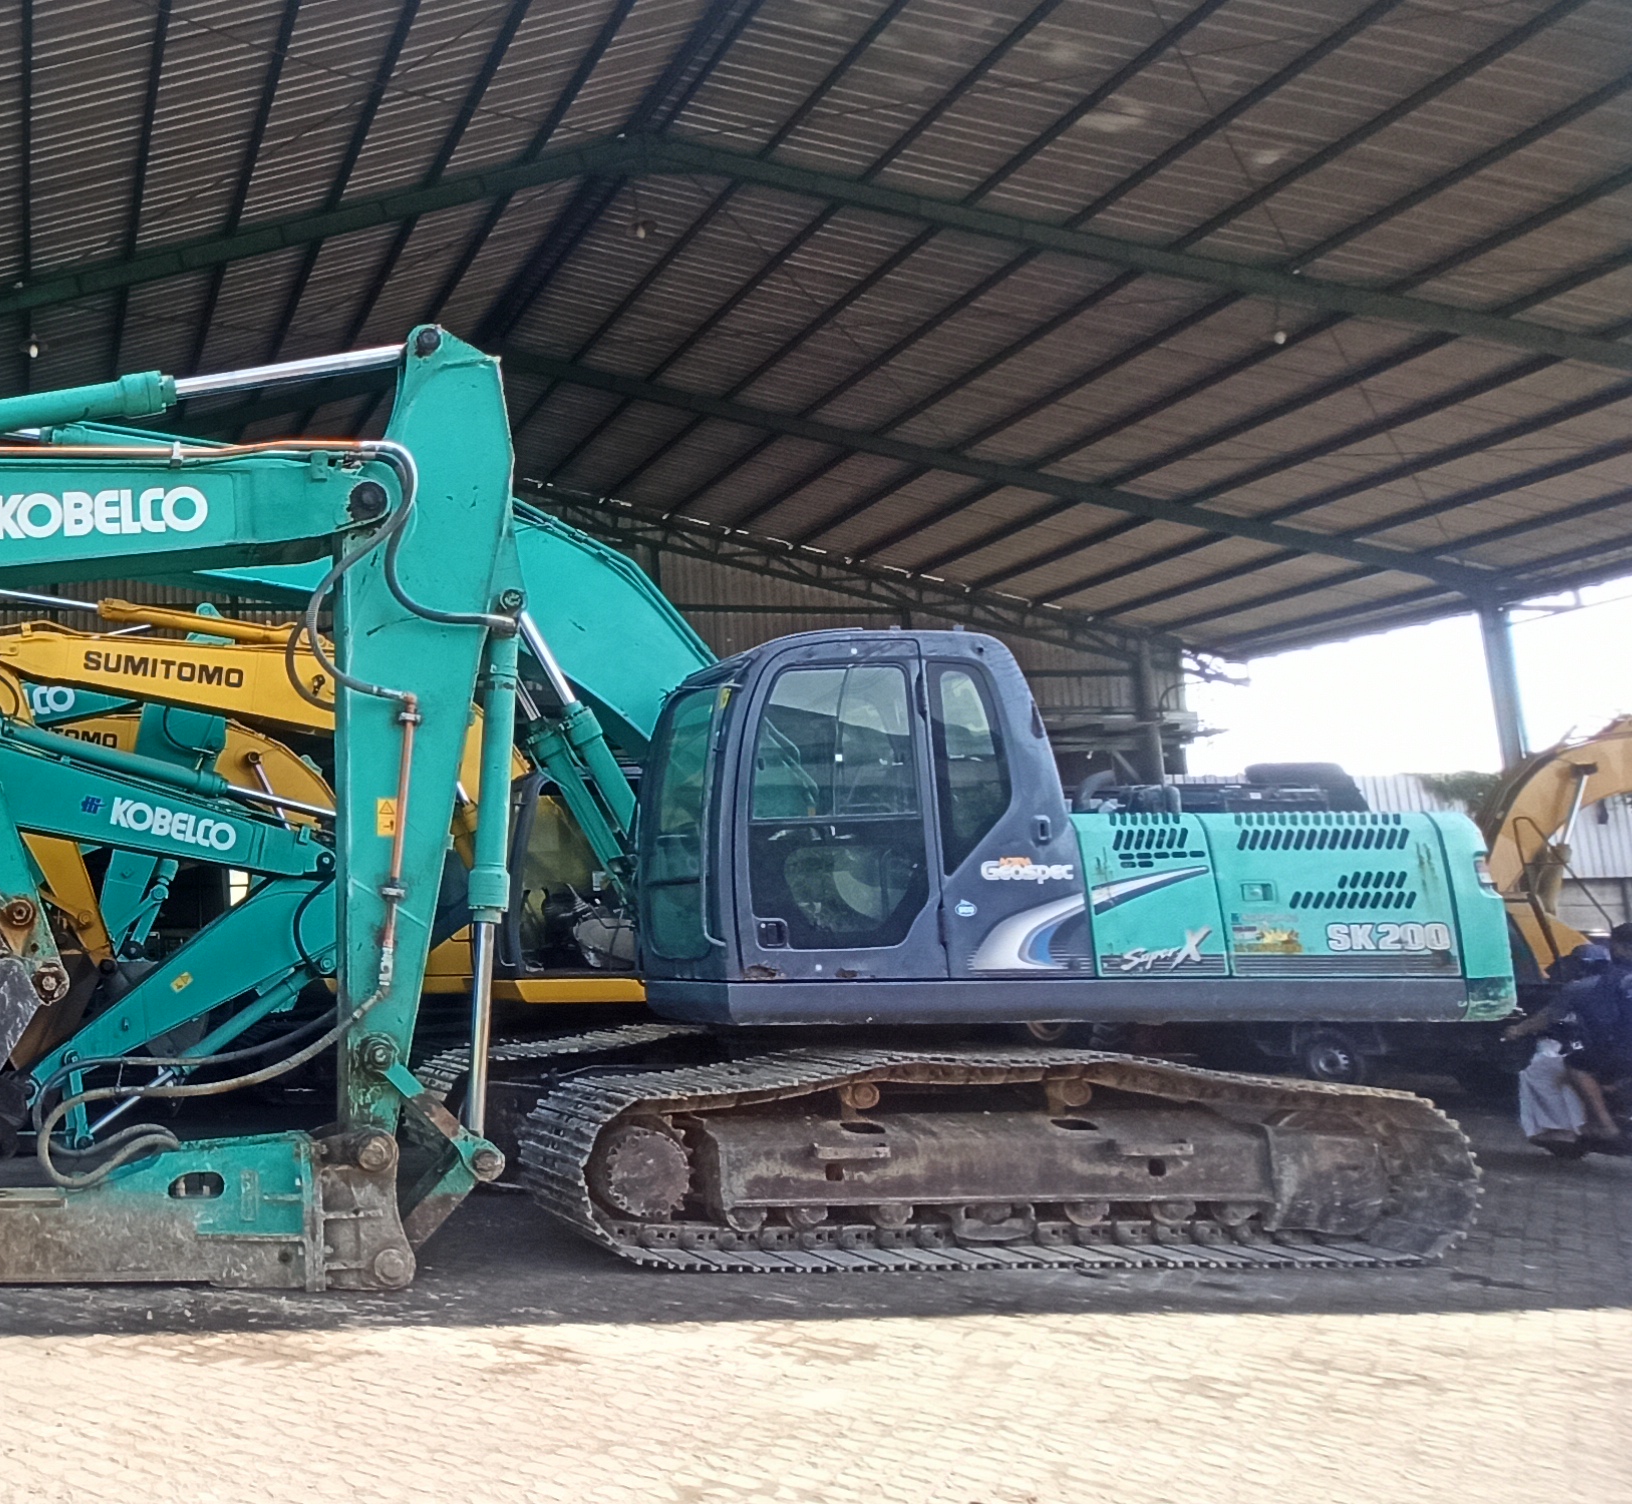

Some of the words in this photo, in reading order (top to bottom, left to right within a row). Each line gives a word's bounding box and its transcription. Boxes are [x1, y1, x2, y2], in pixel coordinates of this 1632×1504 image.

[83, 650, 244, 688] SUMITOMO
[110, 797, 237, 851] KOBELCO
[981, 860, 1074, 885] Geospec
